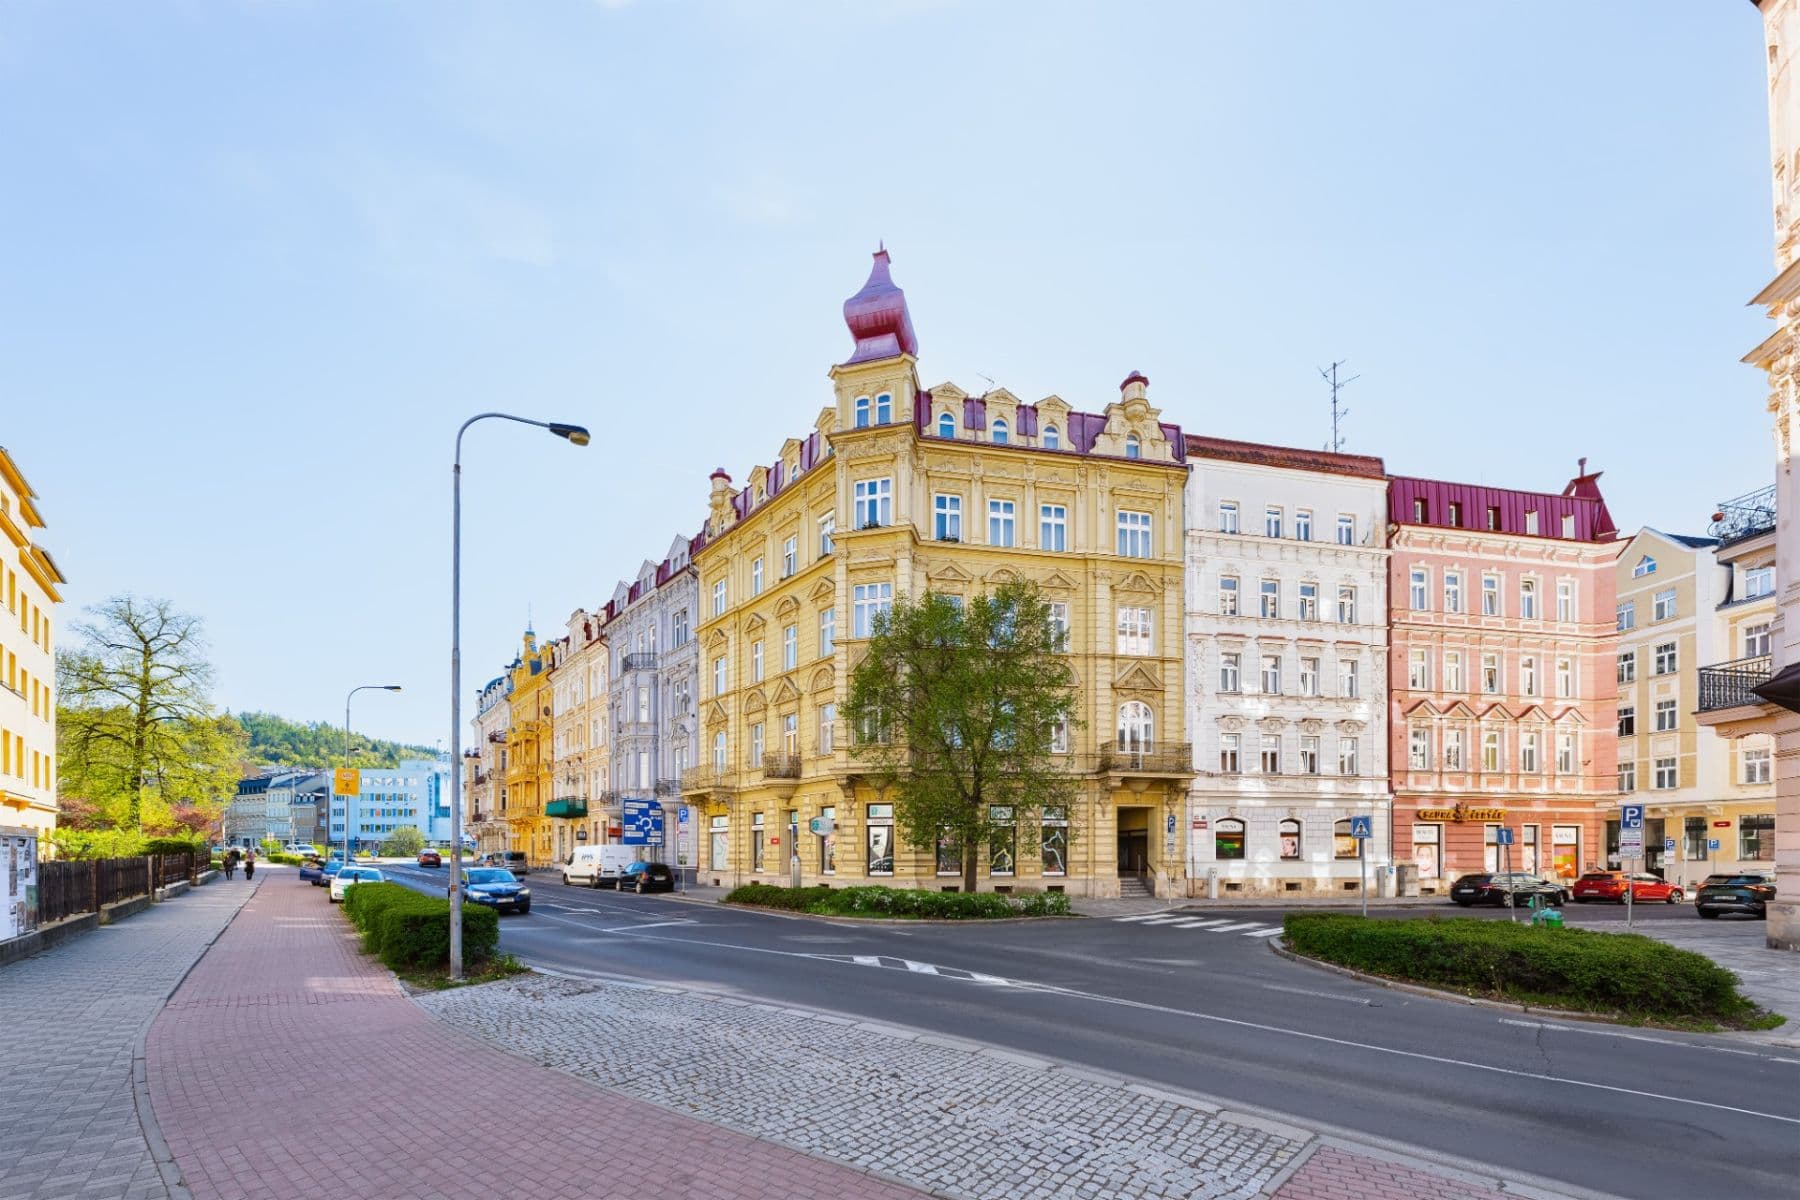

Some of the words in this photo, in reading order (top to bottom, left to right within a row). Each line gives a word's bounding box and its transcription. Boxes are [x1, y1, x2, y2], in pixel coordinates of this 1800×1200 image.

[680, 810, 687, 818] P
[1626, 808, 1638, 821] P
[1169, 817, 1174, 828] P
